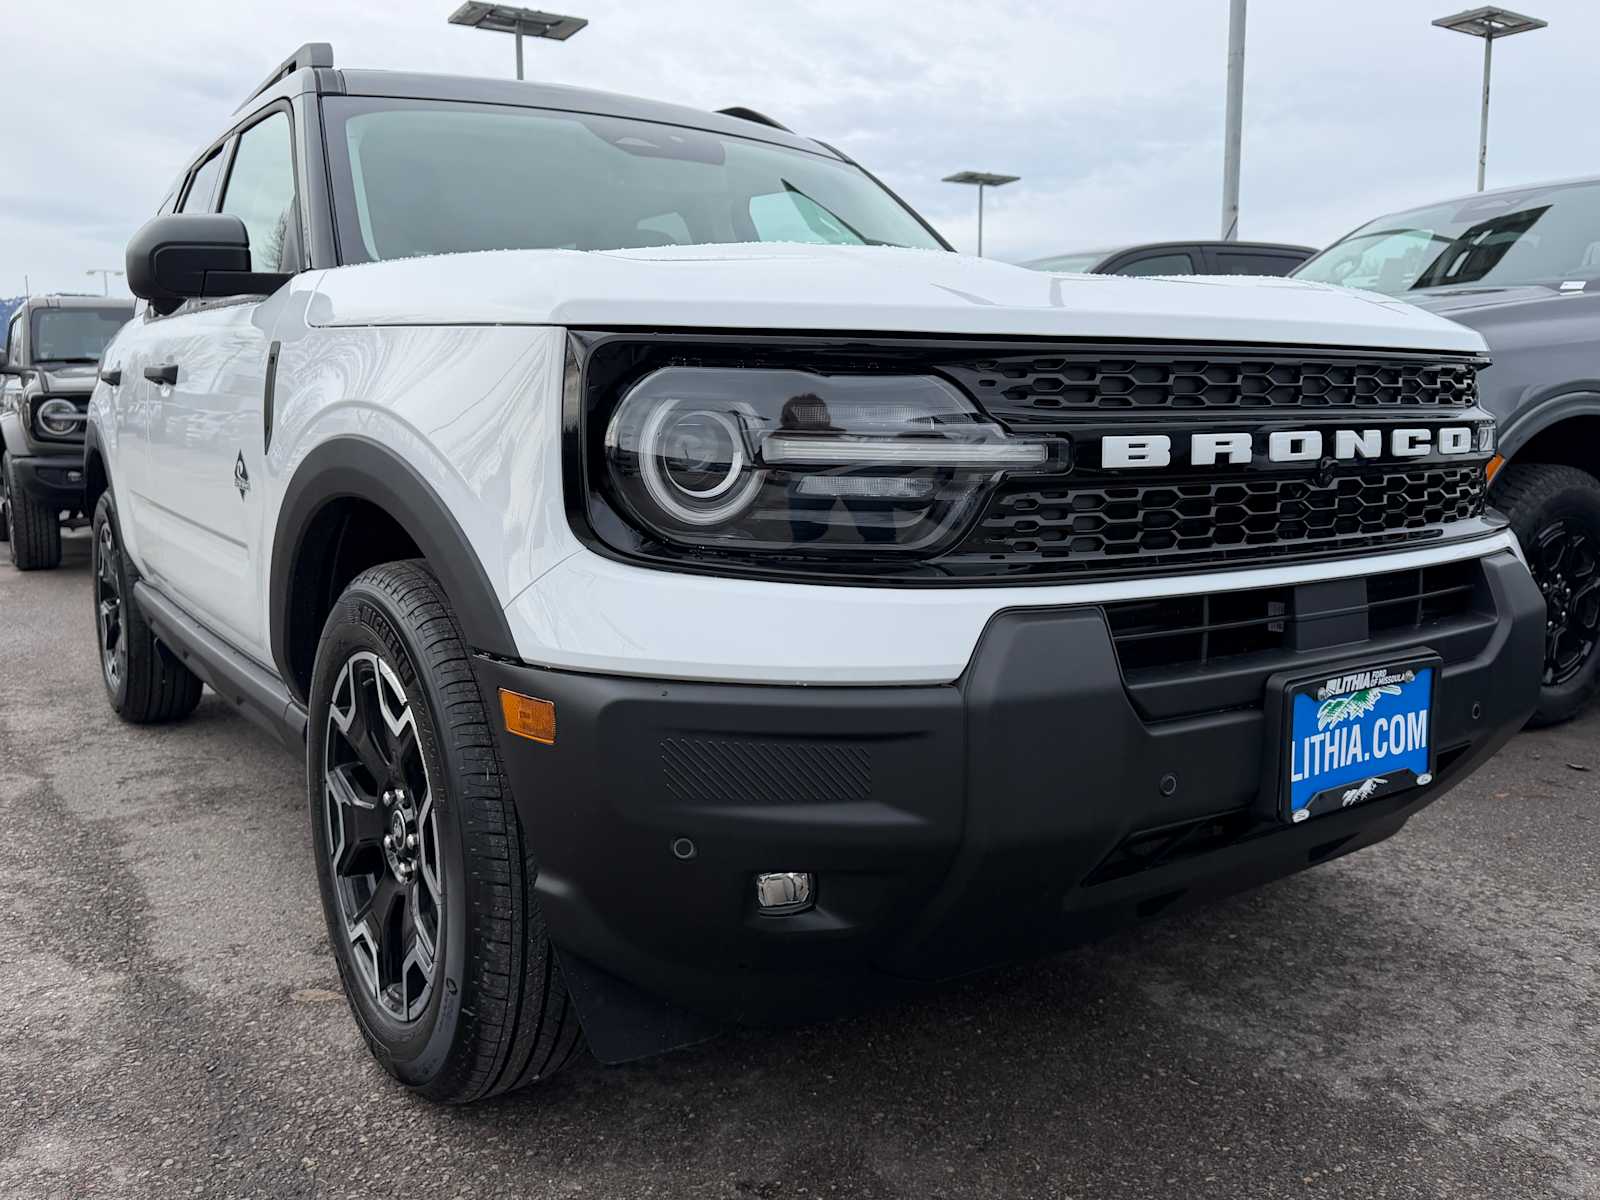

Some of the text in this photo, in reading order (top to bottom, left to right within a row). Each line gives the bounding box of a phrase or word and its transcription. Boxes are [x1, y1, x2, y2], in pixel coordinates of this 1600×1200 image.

[1102, 427, 1472, 468] BRONCO
[361, 604, 414, 686] MICHELIN
[1334, 672, 1370, 695] LITHIA
[1291, 710, 1427, 782] LITHIA.COM
